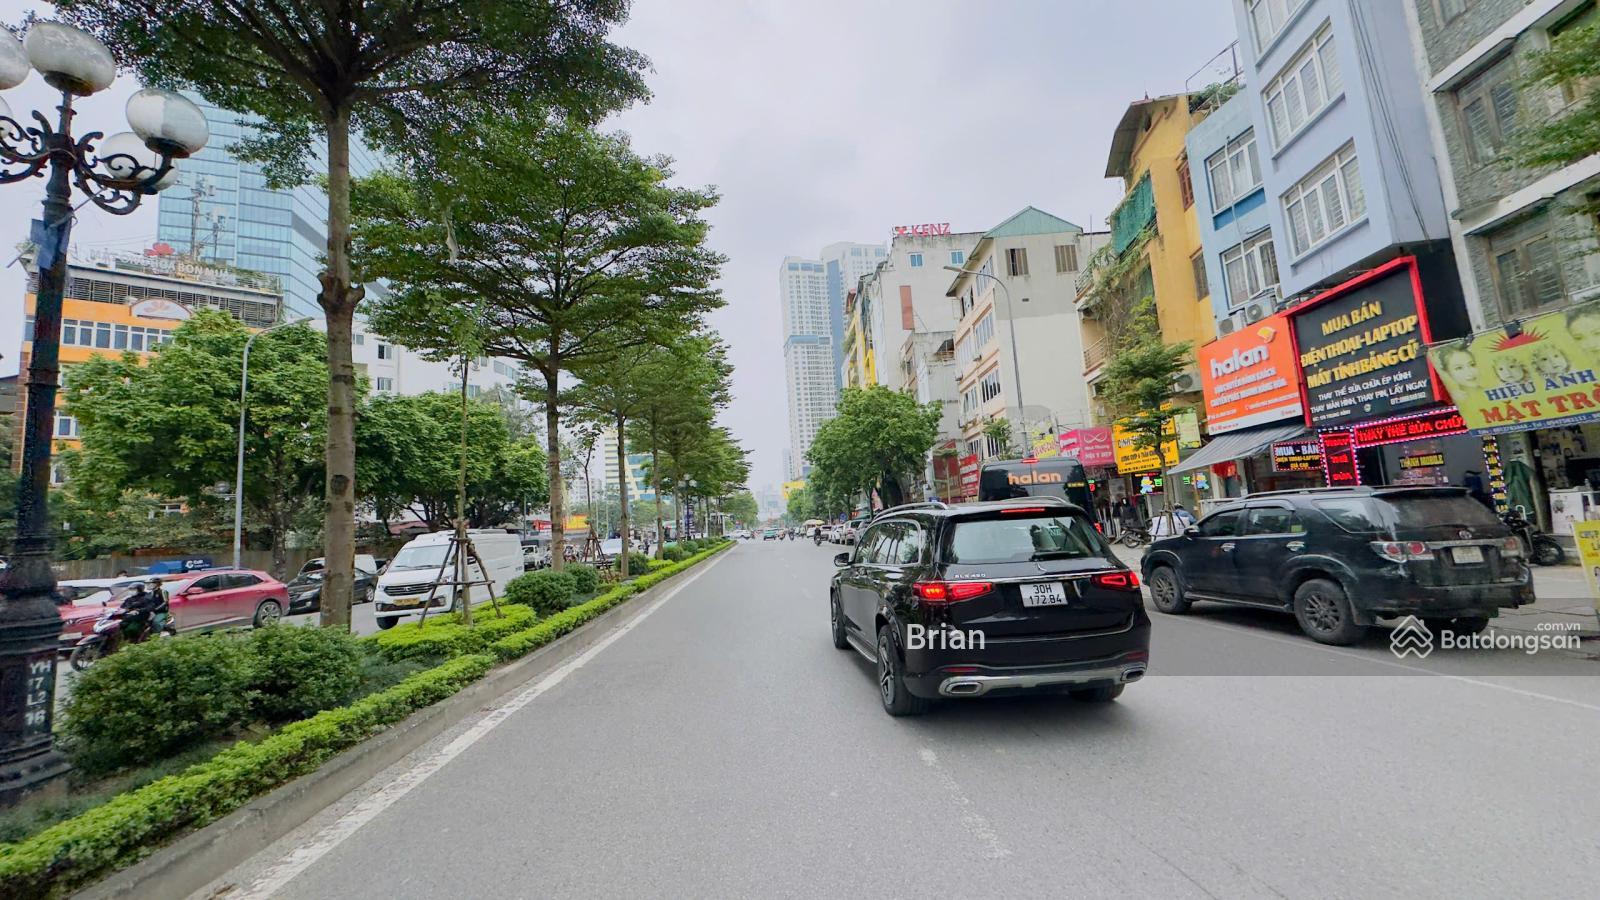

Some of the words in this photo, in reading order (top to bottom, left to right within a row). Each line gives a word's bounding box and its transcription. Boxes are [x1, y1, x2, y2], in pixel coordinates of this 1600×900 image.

[911, 222, 951, 237] KENZ
[1321, 314, 1351, 336] MUA
[1350, 301, 1383, 325] BÁN
[1210, 345, 1269, 378] halan
[1300, 347, 1326, 367] ĐIỆN
[1306, 367, 1332, 389] MÁY
[1331, 361, 1361, 382] TÍNH
[1397, 338, 1420, 362] CŨ
[1318, 392, 1333, 401] THAY
[1335, 385, 1347, 397] THẾ
[1381, 375, 1392, 385] ÉP
[1392, 370, 1412, 382] KÍNH
[1484, 381, 1537, 400] HIỆU
[1310, 404, 1326, 414] THAY
[1357, 392, 1376, 403] THAY
[1389, 384, 1404, 396] LẤY
[1405, 379, 1428, 392] NGAY
[1479, 399, 1542, 423] MẶT
[1357, 428, 1384, 442] THAY
[1276, 446, 1296, 456] MUA
[1300, 443, 1319, 455] BÁN
[1007, 470, 1062, 486] halan
[1034, 584, 1053, 594] 30H
[1029, 594, 1063, 605] 172.84
[25, 709, 46, 726] 16
